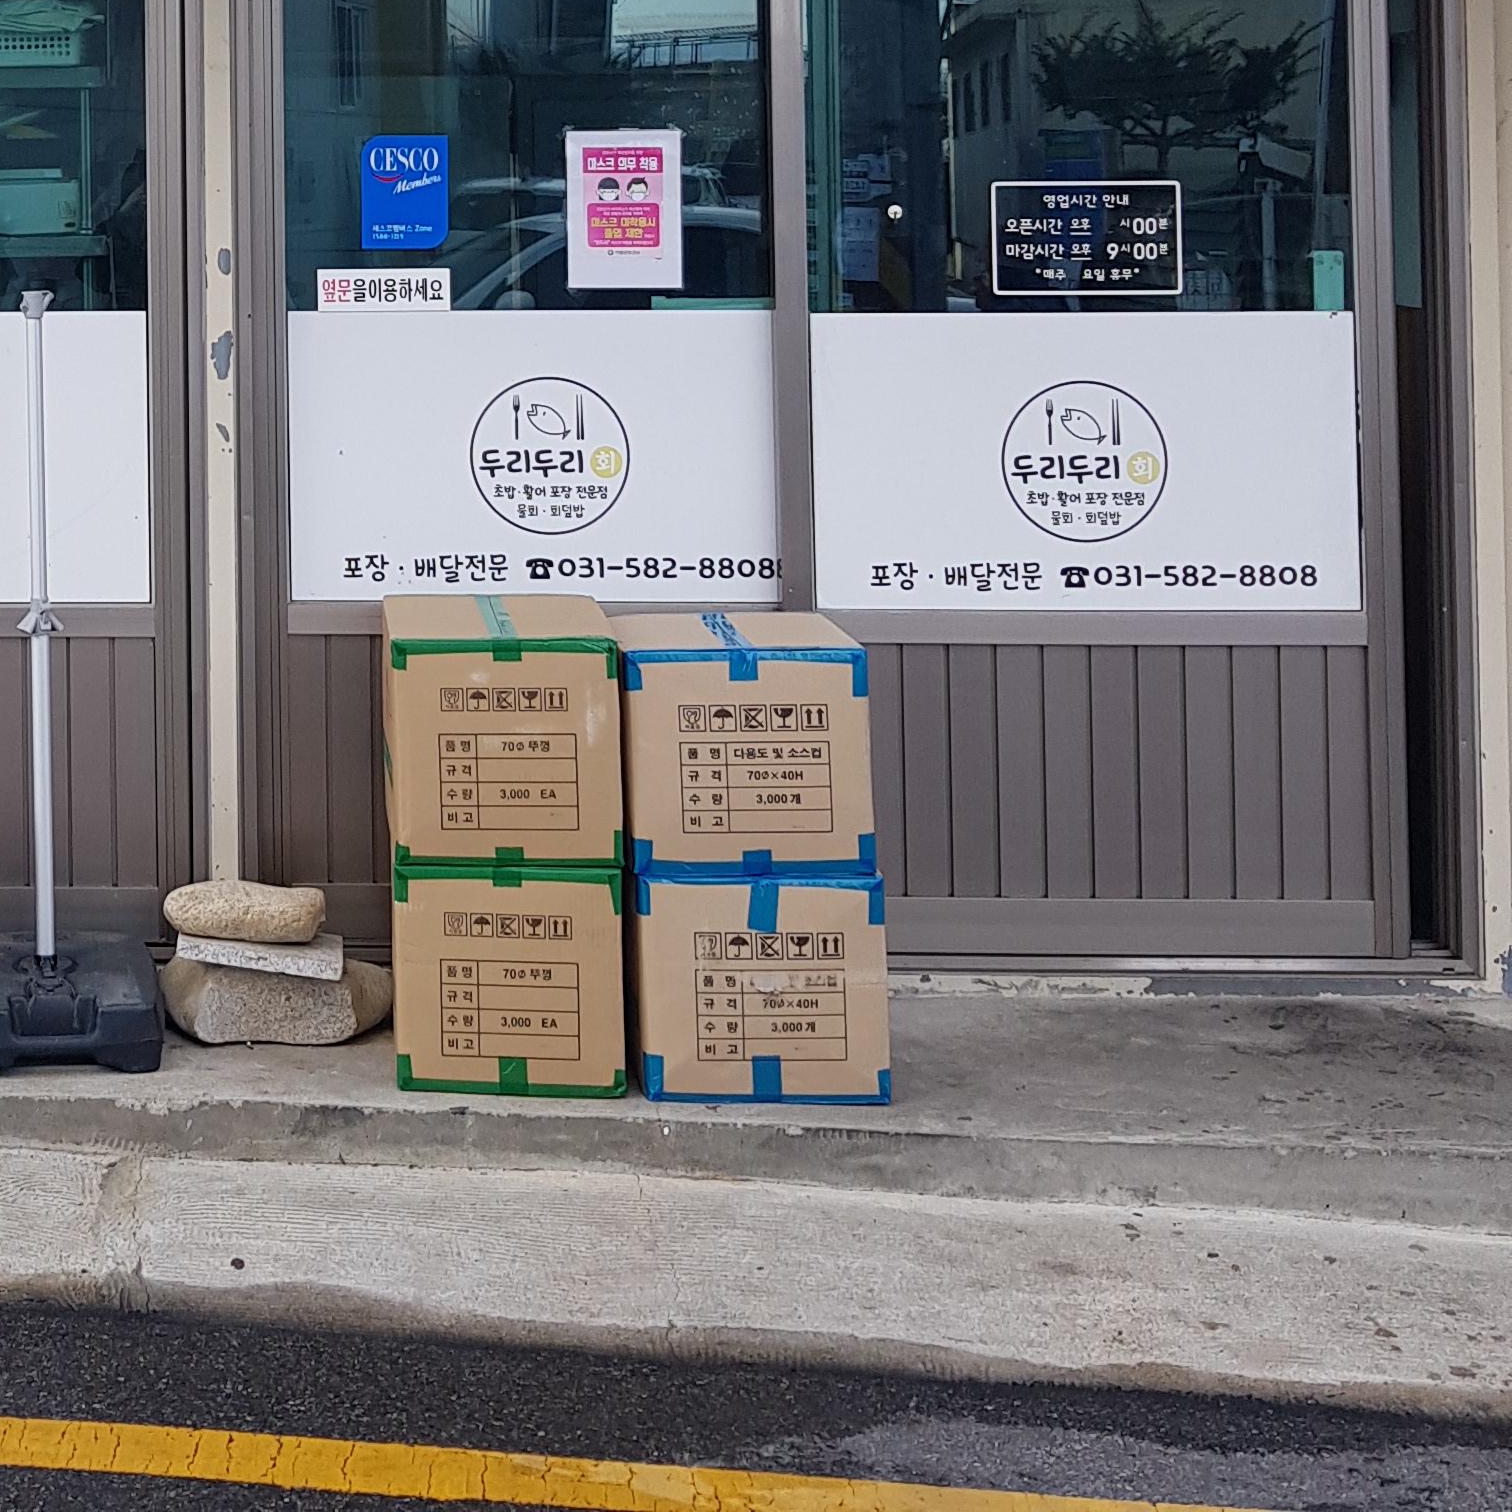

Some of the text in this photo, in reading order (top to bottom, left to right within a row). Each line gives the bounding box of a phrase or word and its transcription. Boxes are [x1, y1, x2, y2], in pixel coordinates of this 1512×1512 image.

[369, 147, 439, 172] CESCO
[587, 156, 658, 171] 마스크 의무 착용
[393, 172, 442, 195] Members
[1043, 194, 1129, 209] 영업시간 안내
[1005, 219, 1063, 235] 오픈시간
[1069, 218, 1091, 230] 오후
[1005, 244, 1064, 260] 마감시간
[1070, 243, 1091, 255] 오후
[1082, 268, 1106, 282] 요일
[322, 278, 444, 303] 옆문을이용하세요
[479, 449, 616, 478] 두리두리 회
[1011, 455, 1153, 484] 두리두리 회
[550, 485, 573, 499] 포장
[576, 485, 608, 499] 전문점
[1085, 492, 1108, 505] 포장
[1111, 492, 1145, 506] 전문점
[517, 504, 539, 518] 물회
[1051, 510, 1074, 526] 물회
[343, 554, 390, 582] 포장
[414, 554, 510, 582] 배달전문
[870, 562, 919, 591] 포장
[944, 562, 1043, 591] 배달전문
[734, 748, 769, 759] 다용도
[773, 747, 783, 759] 및
[787, 747, 822, 759] 소스컵
[500, 788, 530, 800] 3,000
[540, 789, 557, 800] EA
[500, 1016, 531, 1028] 3,000
[542, 1018, 558, 1028] EA
